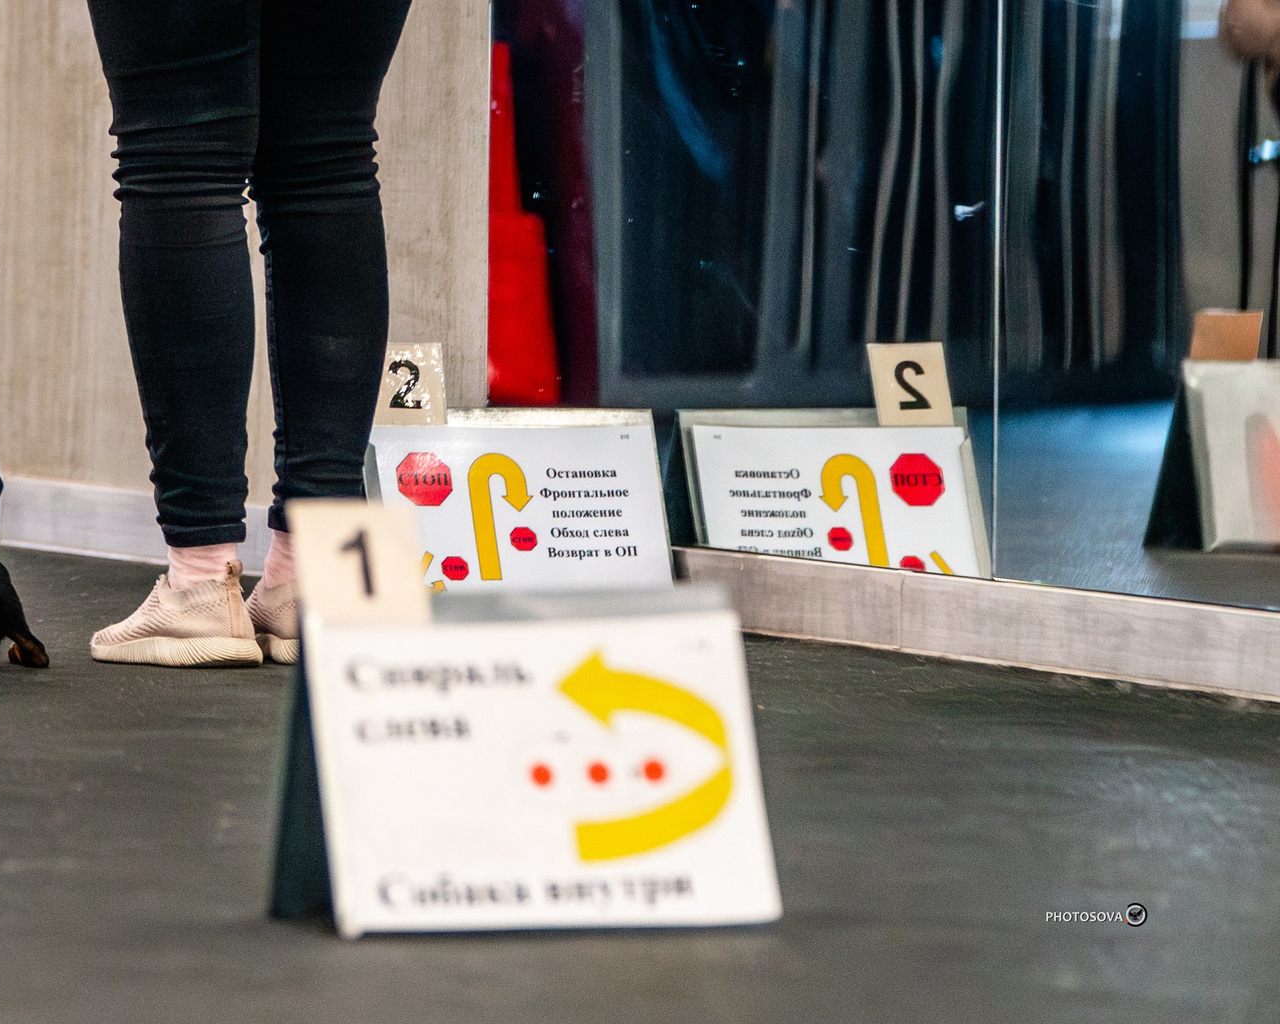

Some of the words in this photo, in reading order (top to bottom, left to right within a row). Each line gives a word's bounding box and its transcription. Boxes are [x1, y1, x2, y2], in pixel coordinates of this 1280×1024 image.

[388, 359, 422, 409] 2
[546, 467, 617, 479] Остановка
[540, 487, 629, 501] Фронтальное
[552, 508, 623, 518] положение
[550, 527, 590, 538] Обход
[592, 528, 629, 538] слева
[548, 547, 600, 561] Возврат
[604, 549, 612, 557] в
[615, 545, 638, 557] ОП
[338, 528, 374, 597] 1
